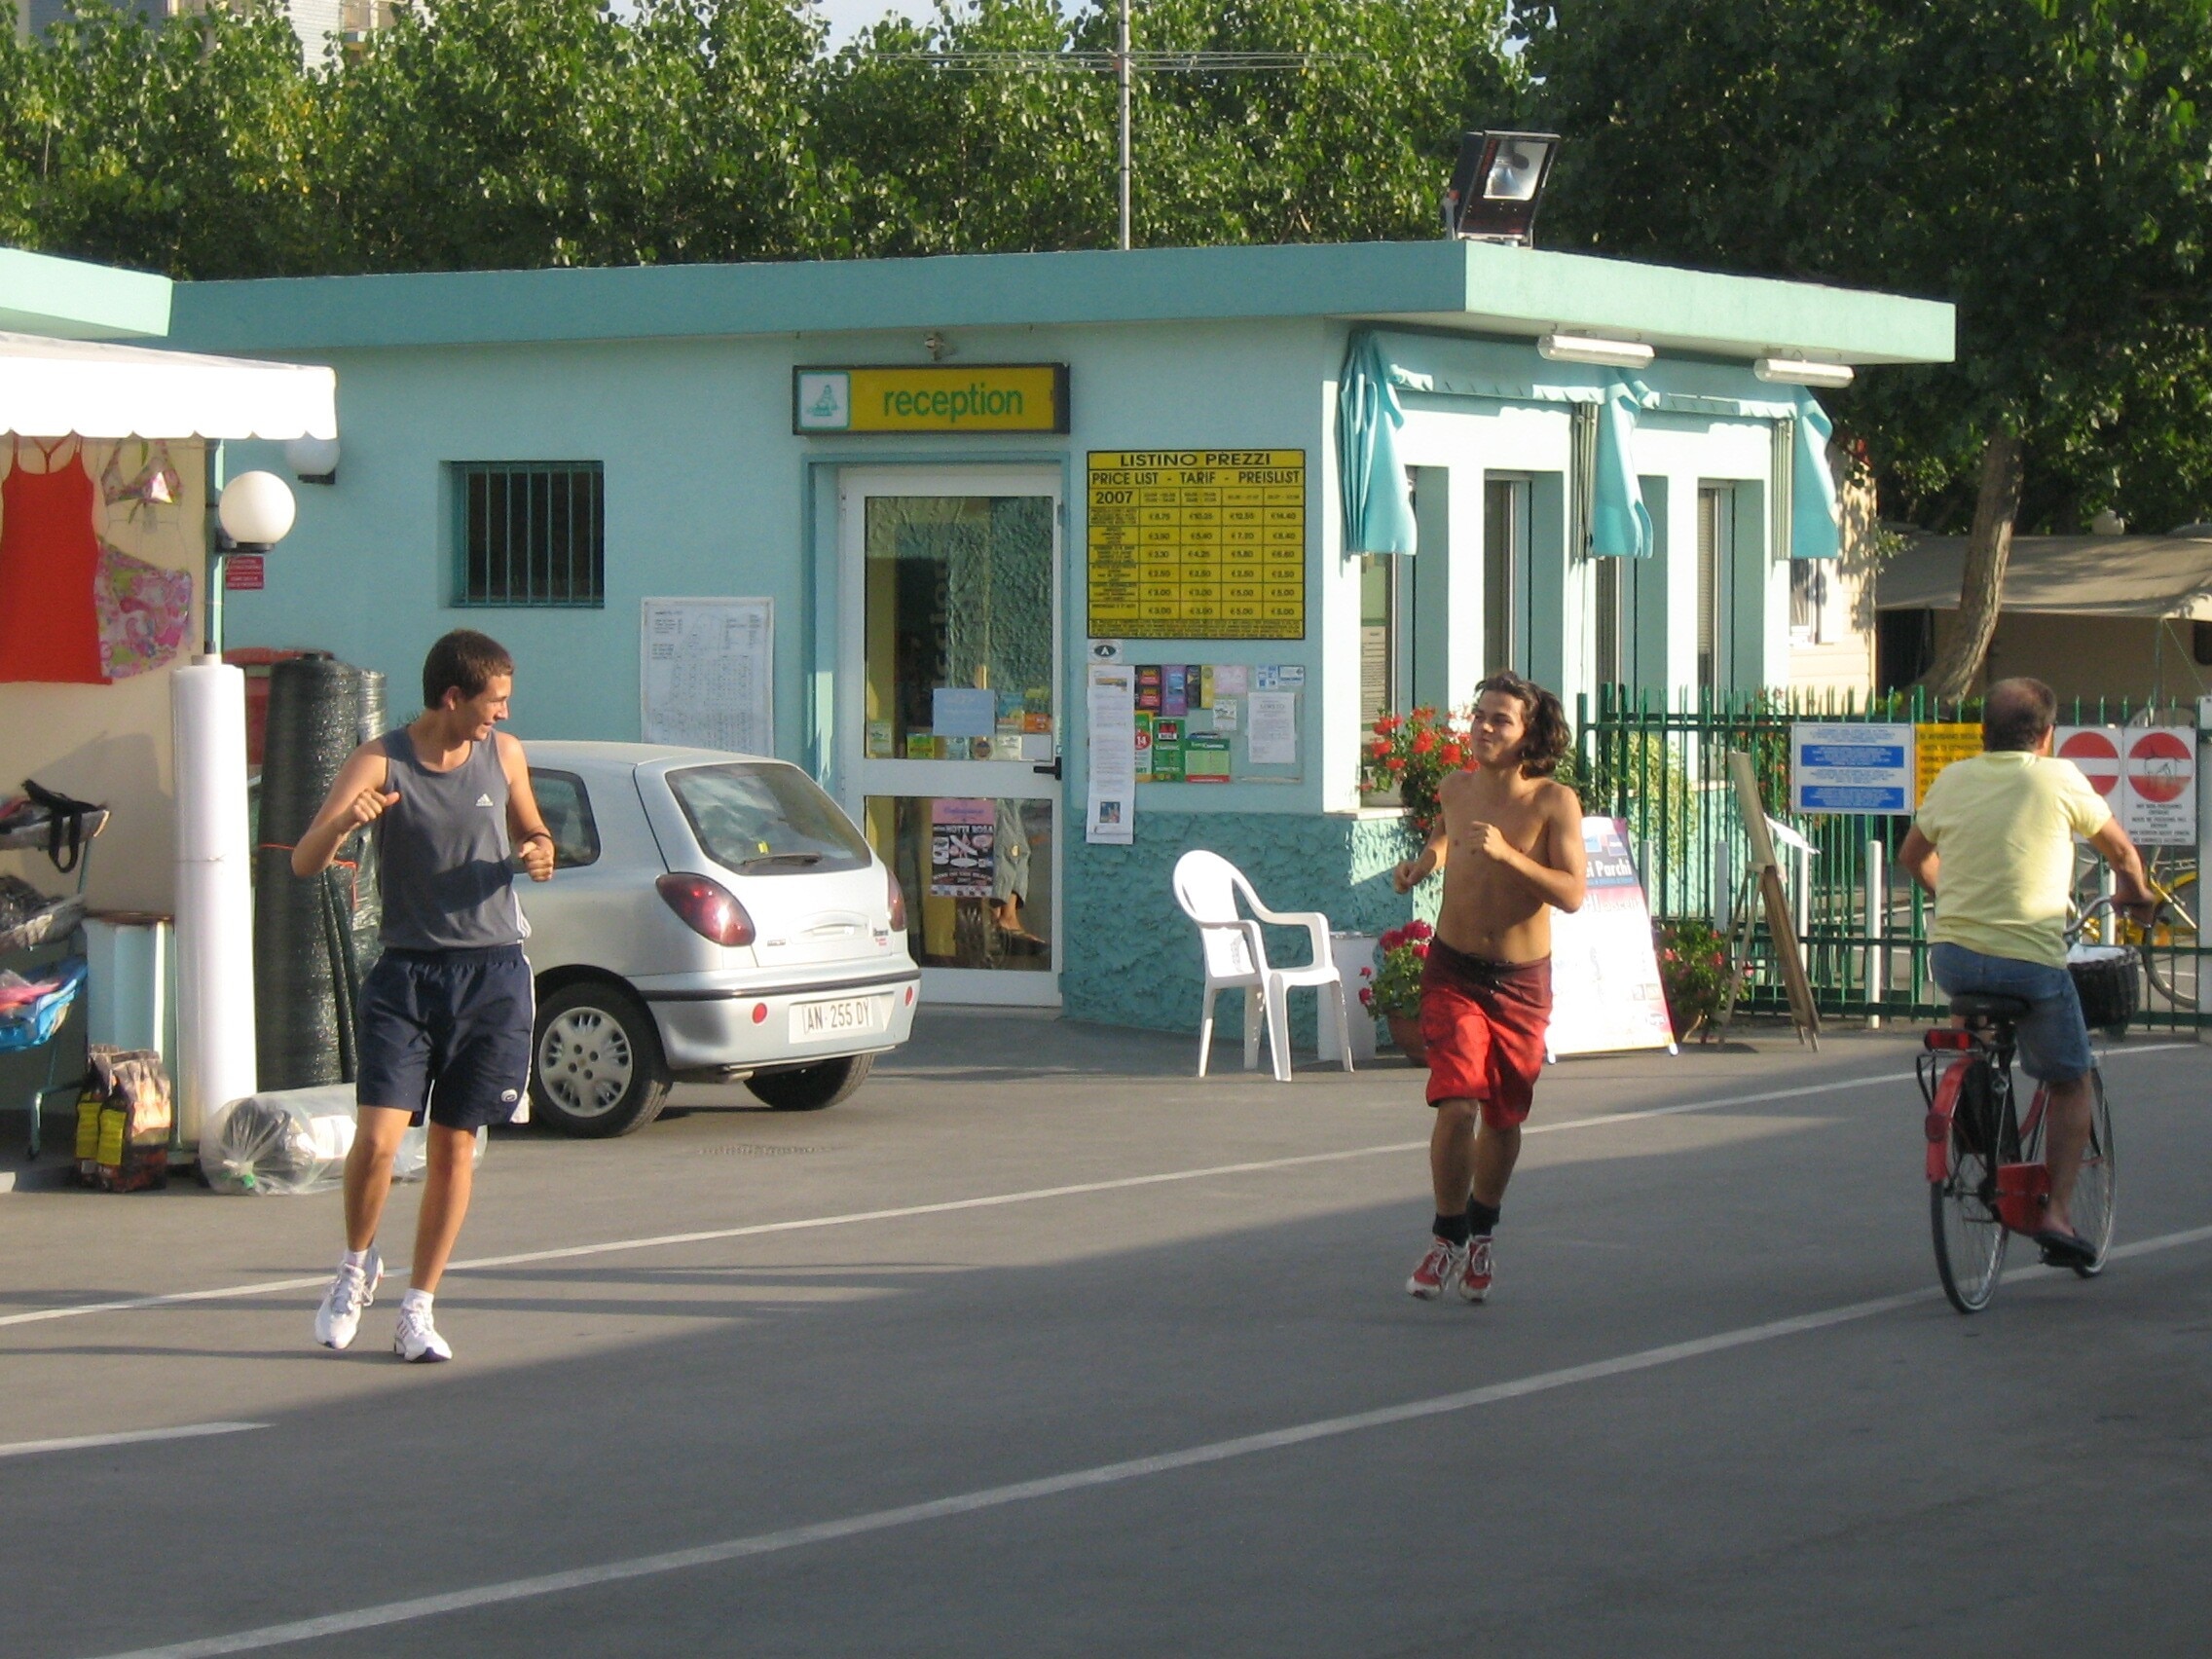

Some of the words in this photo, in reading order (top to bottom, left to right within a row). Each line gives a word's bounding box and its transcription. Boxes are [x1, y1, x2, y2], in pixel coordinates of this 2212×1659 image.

[883, 383, 1024, 424] reception
[1120, 454, 1198, 467] LISTINO
[1205, 453, 1271, 466] PREZZI
[1091, 471, 1130, 486] PRICE
[1134, 471, 1159, 485] LIST
[1179, 471, 1216, 485] TARIF
[1237, 469, 1300, 485] PREISLIST
[1095, 490, 1134, 504] 2007
[1595, 858, 1633, 877] Parchi
[807, 1005, 824, 1030] AN
[830, 1002, 853, 1028] 255
[856, 998, 869, 1027] DY
